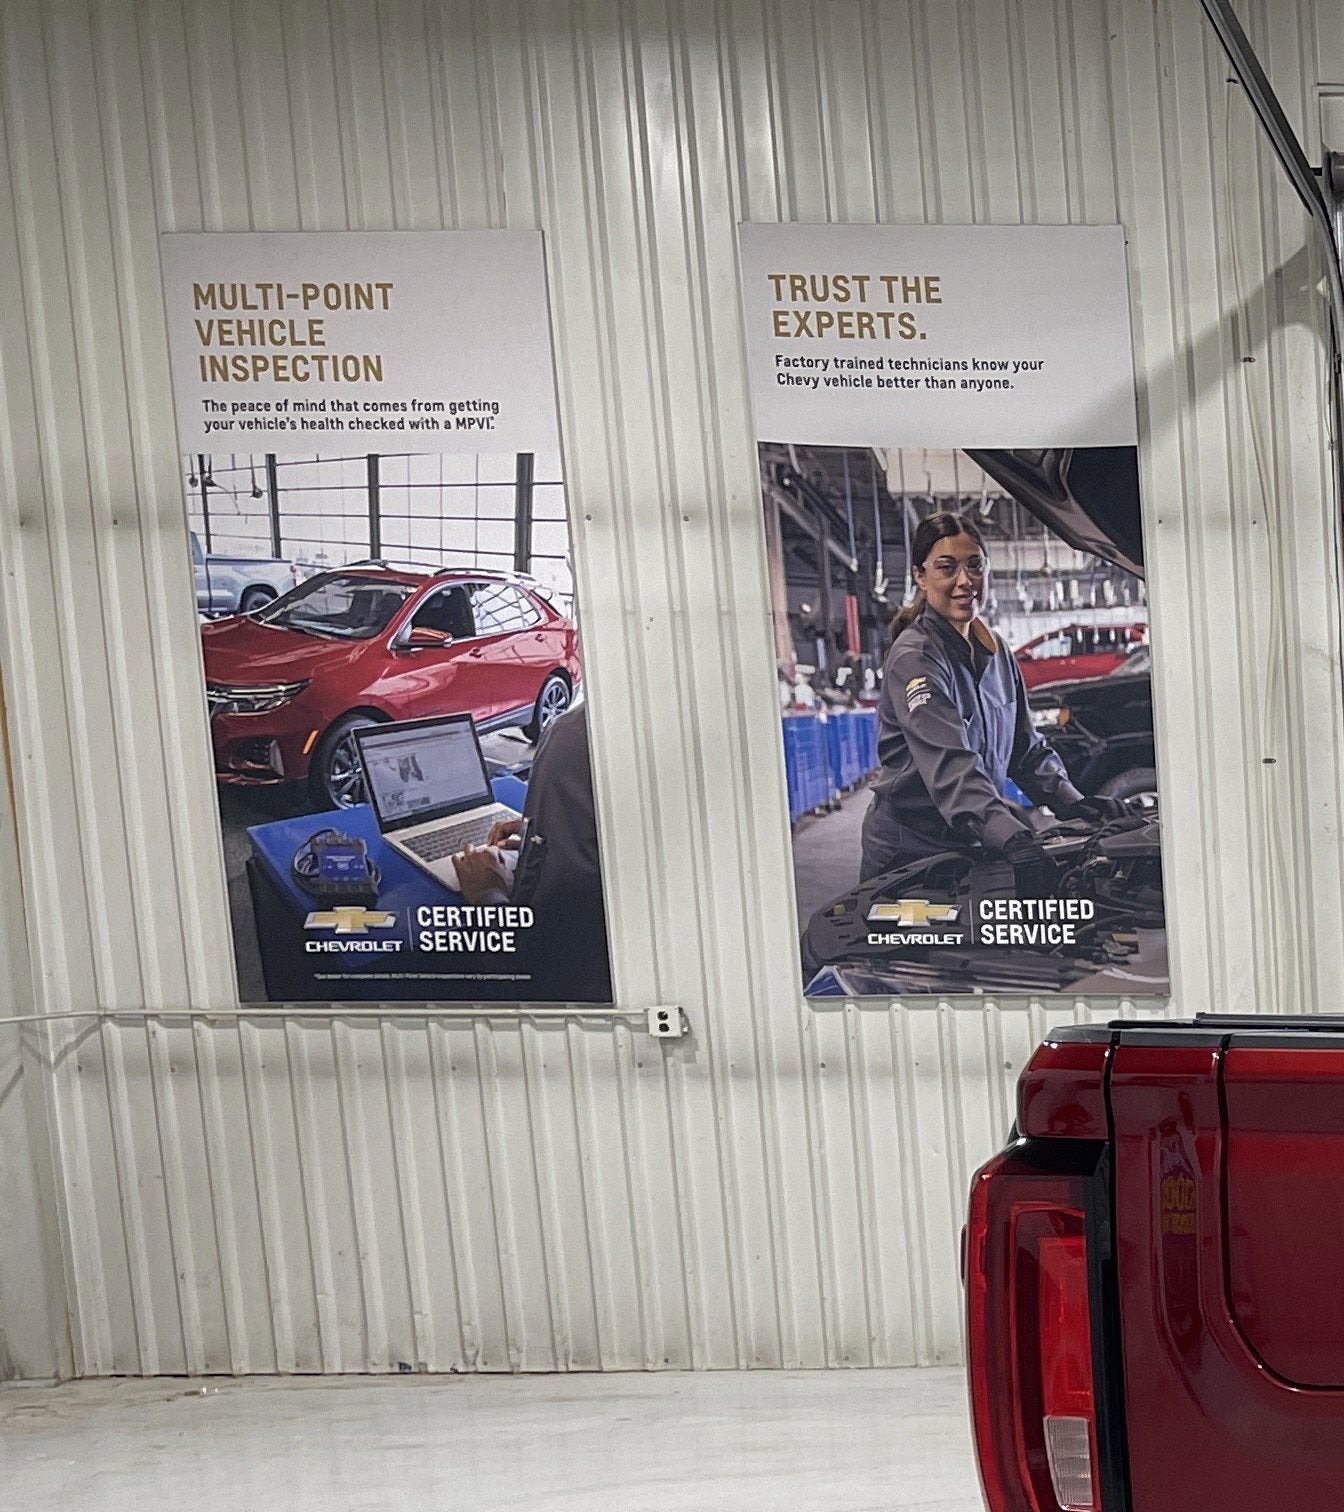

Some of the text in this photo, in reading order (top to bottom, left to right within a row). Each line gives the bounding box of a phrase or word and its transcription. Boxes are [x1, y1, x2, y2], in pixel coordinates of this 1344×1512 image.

[193, 282, 394, 311] MULTI-POINT
[768, 274, 943, 304] TRUST THE
[194, 319, 326, 347] VEHICLE
[772, 310, 928, 340] EXPERTS.
[200, 354, 384, 382] INSPECTION
[775, 354, 1045, 374] Factory trained technicians know your
[777, 372, 1015, 392] Chevy vehicle better than anyone.
[202, 398, 499, 415] The peace of mind that comes from getting
[204, 420, 235, 433] your
[239, 416, 297, 430] vehicle's
[301, 416, 344, 430] health
[348, 416, 405, 430] checked
[408, 416, 440, 430] with
[444, 419, 452, 430] a
[417, 906, 534, 929] CERTIFIED
[979, 898, 1095, 921] CERTIFIED
[419, 931, 516, 953] SERVICE
[867, 932, 964, 946] CHEVROLET
[980, 924, 1076, 945] SERVICE
[304, 939, 403, 953] CHEVROLET
